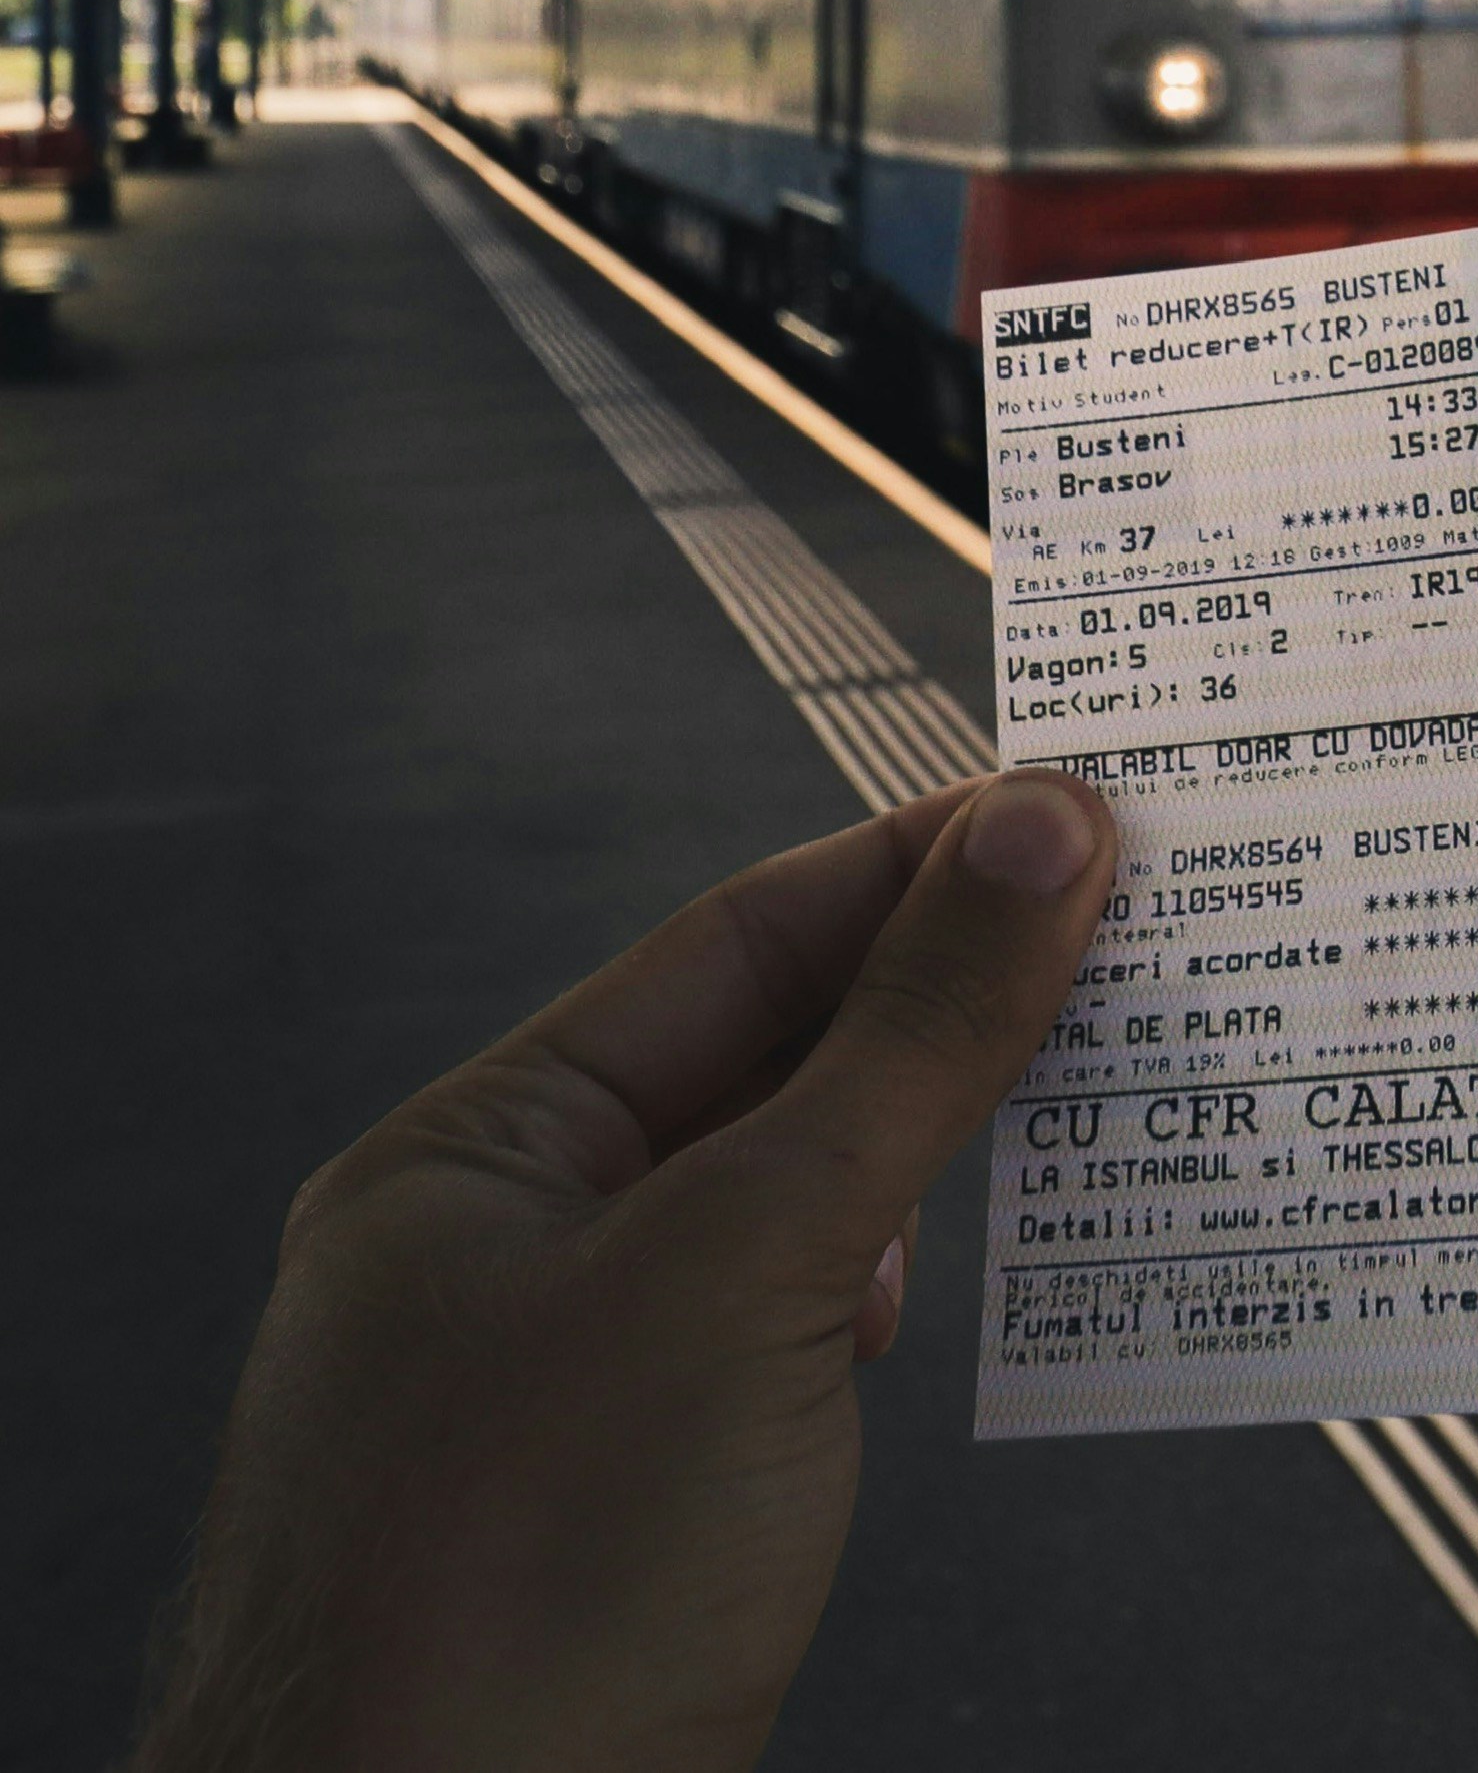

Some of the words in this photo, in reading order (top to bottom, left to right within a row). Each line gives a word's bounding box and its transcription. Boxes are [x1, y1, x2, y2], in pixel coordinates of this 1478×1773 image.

[995, 303, 1090, 339] SNTFC
[1117, 313, 1139, 328] No
[1147, 286, 1296, 327] DHRX8565
[1324, 264, 1447, 304] BUSTENI
[996, 348, 1088, 379] Bilet
[998, 397, 1062, 416] Motiv
[1074, 384, 1166, 407] Student
[1057, 423, 1186, 461] Busteni
[1388, 386, 1478, 421] 14:33
[1058, 470, 1172, 499] Brasov
[1002, 526, 1040, 540] Via
[1081, 540, 1106, 556] Km
[1119, 526, 1156, 553] 37
[1199, 525, 1235, 543] Lei
[1080, 591, 1272, 636] 01.09.2019
[1334, 586, 1395, 606] Tren:
[1271, 628, 1288, 655] 2
[1009, 683, 1178, 722] Loc(uri):
[1201, 673, 1237, 702] 36
[1062, 743, 1196, 782] VALABIL
[1217, 736, 1291, 768] DOAR
[1312, 729, 1349, 758] CU
[1097, 778, 1156, 799] tului
[1214, 764, 1320, 787] reducere
[1335, 753, 1428, 774] conform
[1129, 861, 1153, 877] No
[1171, 835, 1323, 876] DHRX8564
[1150, 878, 1303, 918] 11054545
[1088, 921, 1185, 947] ntegral
[1073, 951, 1161, 986] uceri
[1187, 938, 1342, 976] acordate
[1040, 1021, 1104, 1052] TAL
[1126, 1015, 1164, 1045] DE
[1185, 1005, 1282, 1040] PLATA
[1062, 1064, 1115, 1083] care
[1131, 1056, 1171, 1076] TVA
[1186, 1052, 1226, 1073] 19%
[1255, 1047, 1293, 1067] Lei
[1026, 1102, 1103, 1151] CU
[1145, 1092, 1260, 1143] CFR
[1020, 1165, 1059, 1195] LA
[1083, 1152, 1239, 1191] ISTANBUL
[1262, 1148, 1296, 1178] si
[1018, 1206, 1173, 1244] Detalii:
[1049, 1263, 1187, 1290] deschideti
[1295, 1255, 1317, 1274] in
[1003, 1302, 1141, 1341] Fumatul
[1172, 1292, 1331, 1331] interzis
[1358, 1287, 1395, 1319] in
[1121, 1286, 1146, 1304] de
[1001, 1343, 1097, 1365] Valabil
[1118, 1343, 1145, 1360] cu
